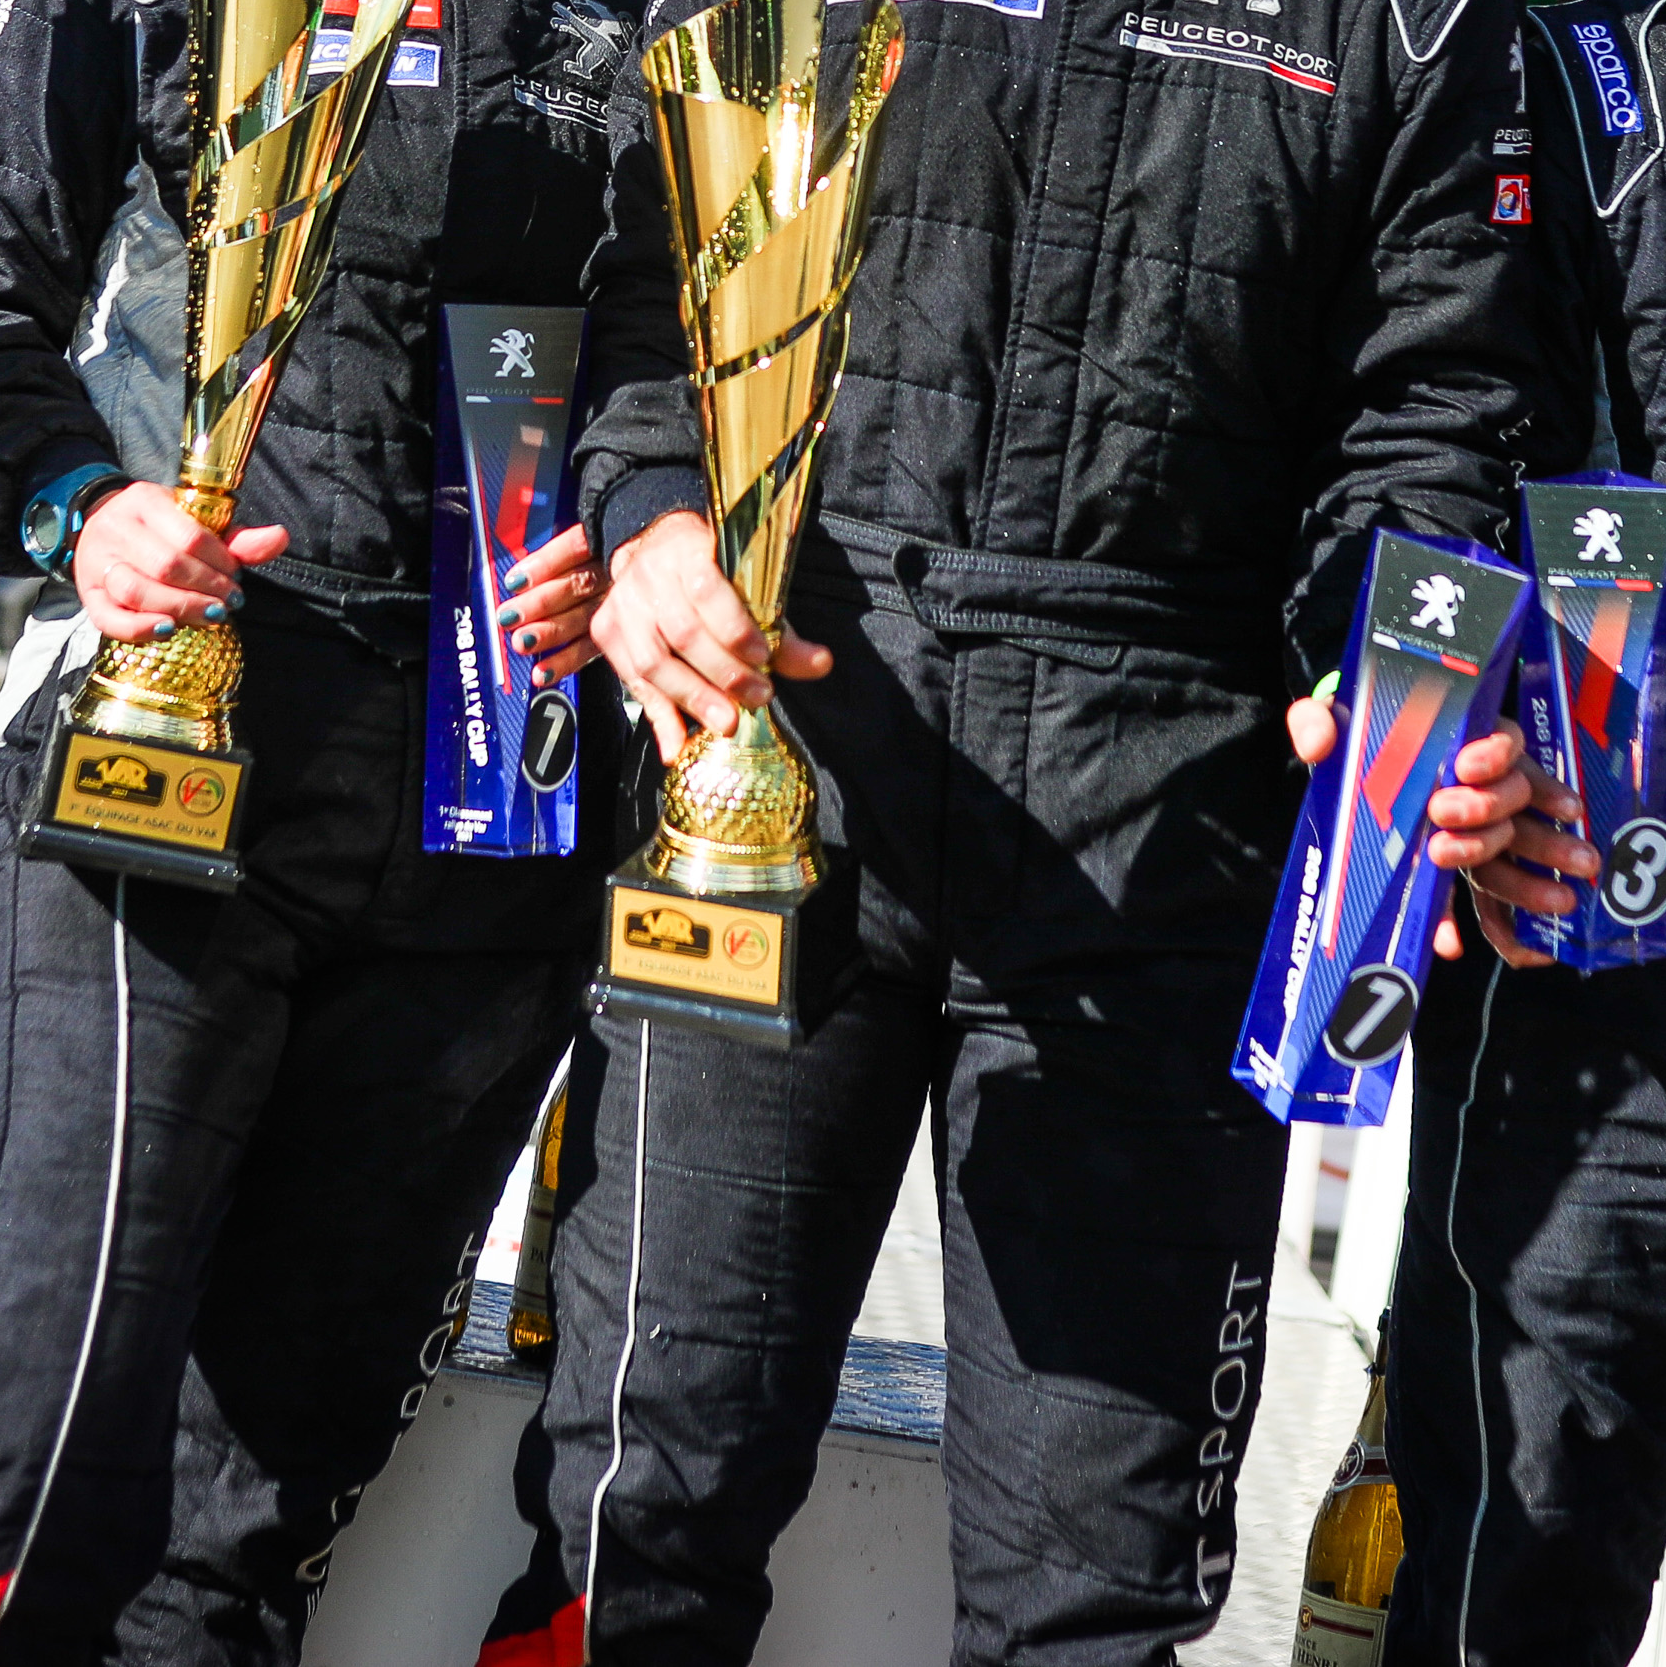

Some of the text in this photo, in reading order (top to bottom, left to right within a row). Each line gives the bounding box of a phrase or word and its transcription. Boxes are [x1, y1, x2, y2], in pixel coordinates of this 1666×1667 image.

[1124, 11, 1338, 78] PEUGEOT SPORT
[1578, 23, 1635, 130] sparco
[512, 74, 609, 117] PEUGE
[452, 605, 489, 768] 208 RALLY CUP
[1532, 697, 1552, 743] 208
[535, 703, 569, 778] 1
[1282, 844, 1323, 1023] 208 RALLY CUP
[1343, 975, 1407, 1053] 1
[1196, 1260, 1263, 1520] SPORT
